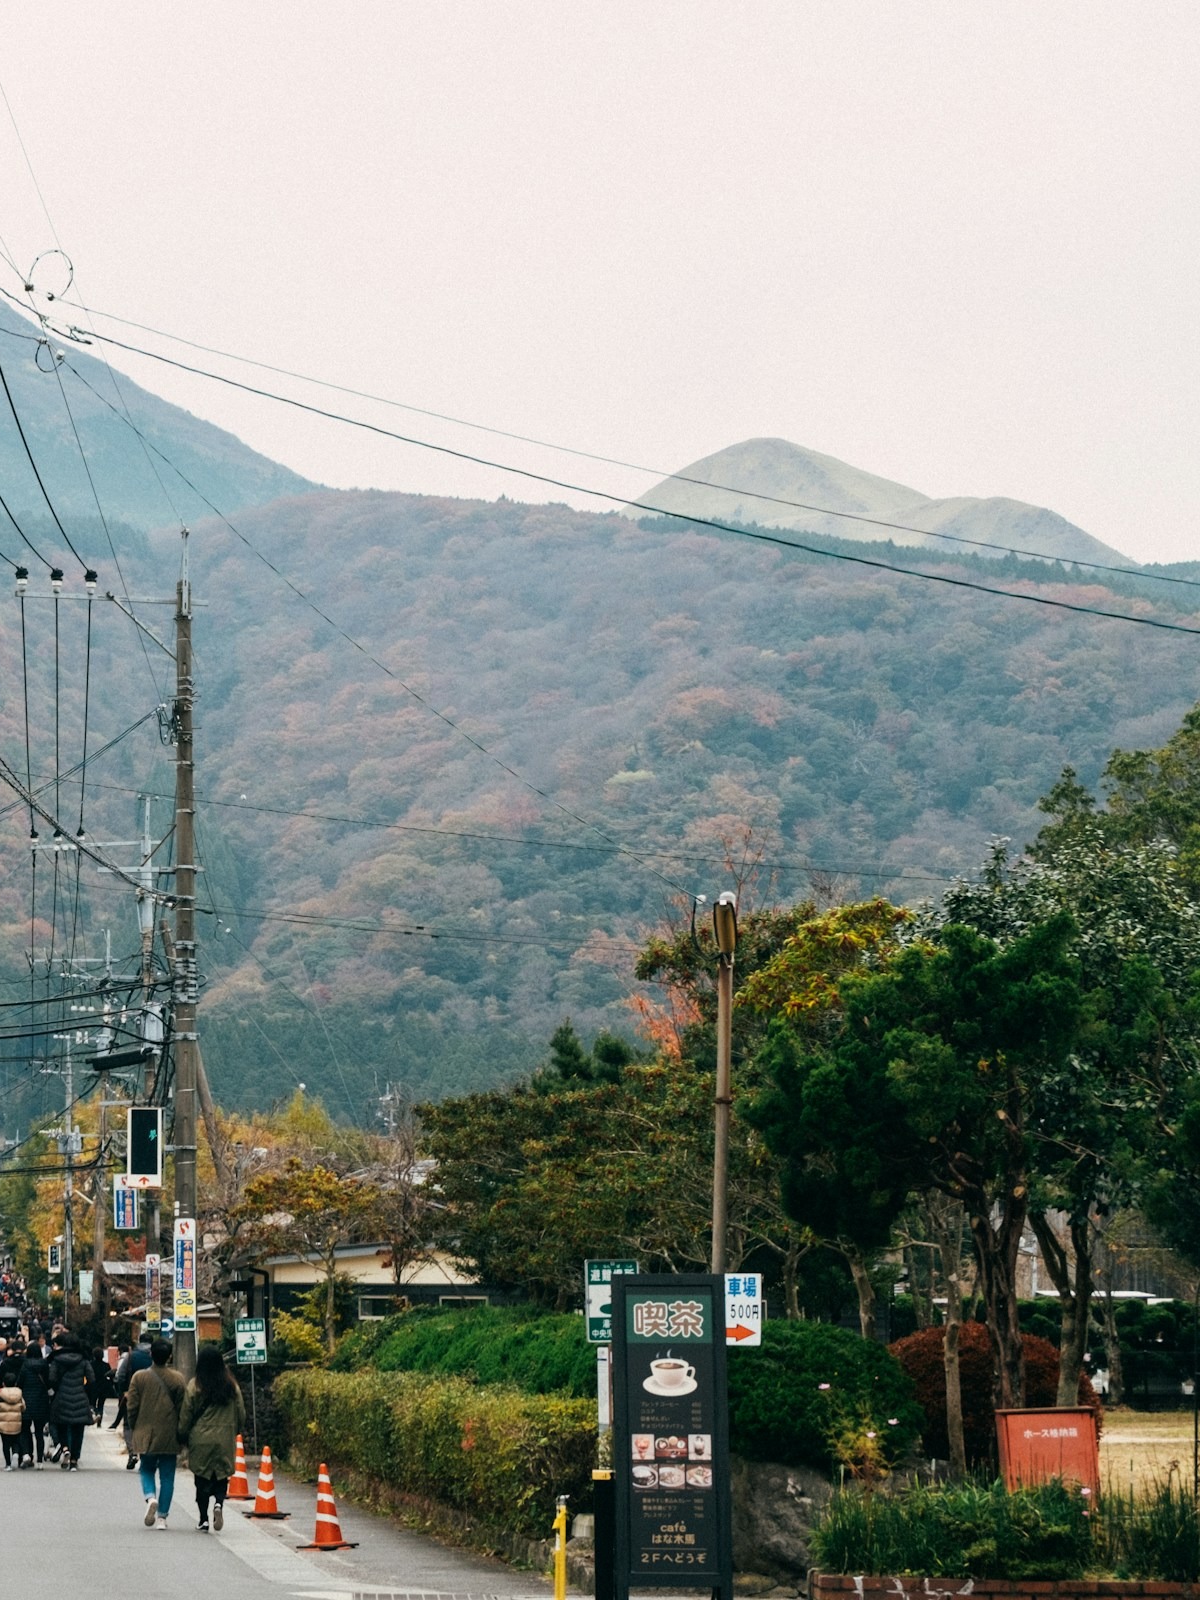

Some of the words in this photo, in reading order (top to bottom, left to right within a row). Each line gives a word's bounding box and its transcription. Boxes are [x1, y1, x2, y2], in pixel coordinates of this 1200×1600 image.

[727, 1277, 757, 1298] 車場
[634, 1301, 703, 1338] 喫茶
[730, 1304, 759, 1320] 500円
[652, 1534, 696, 1545] はな木馬
